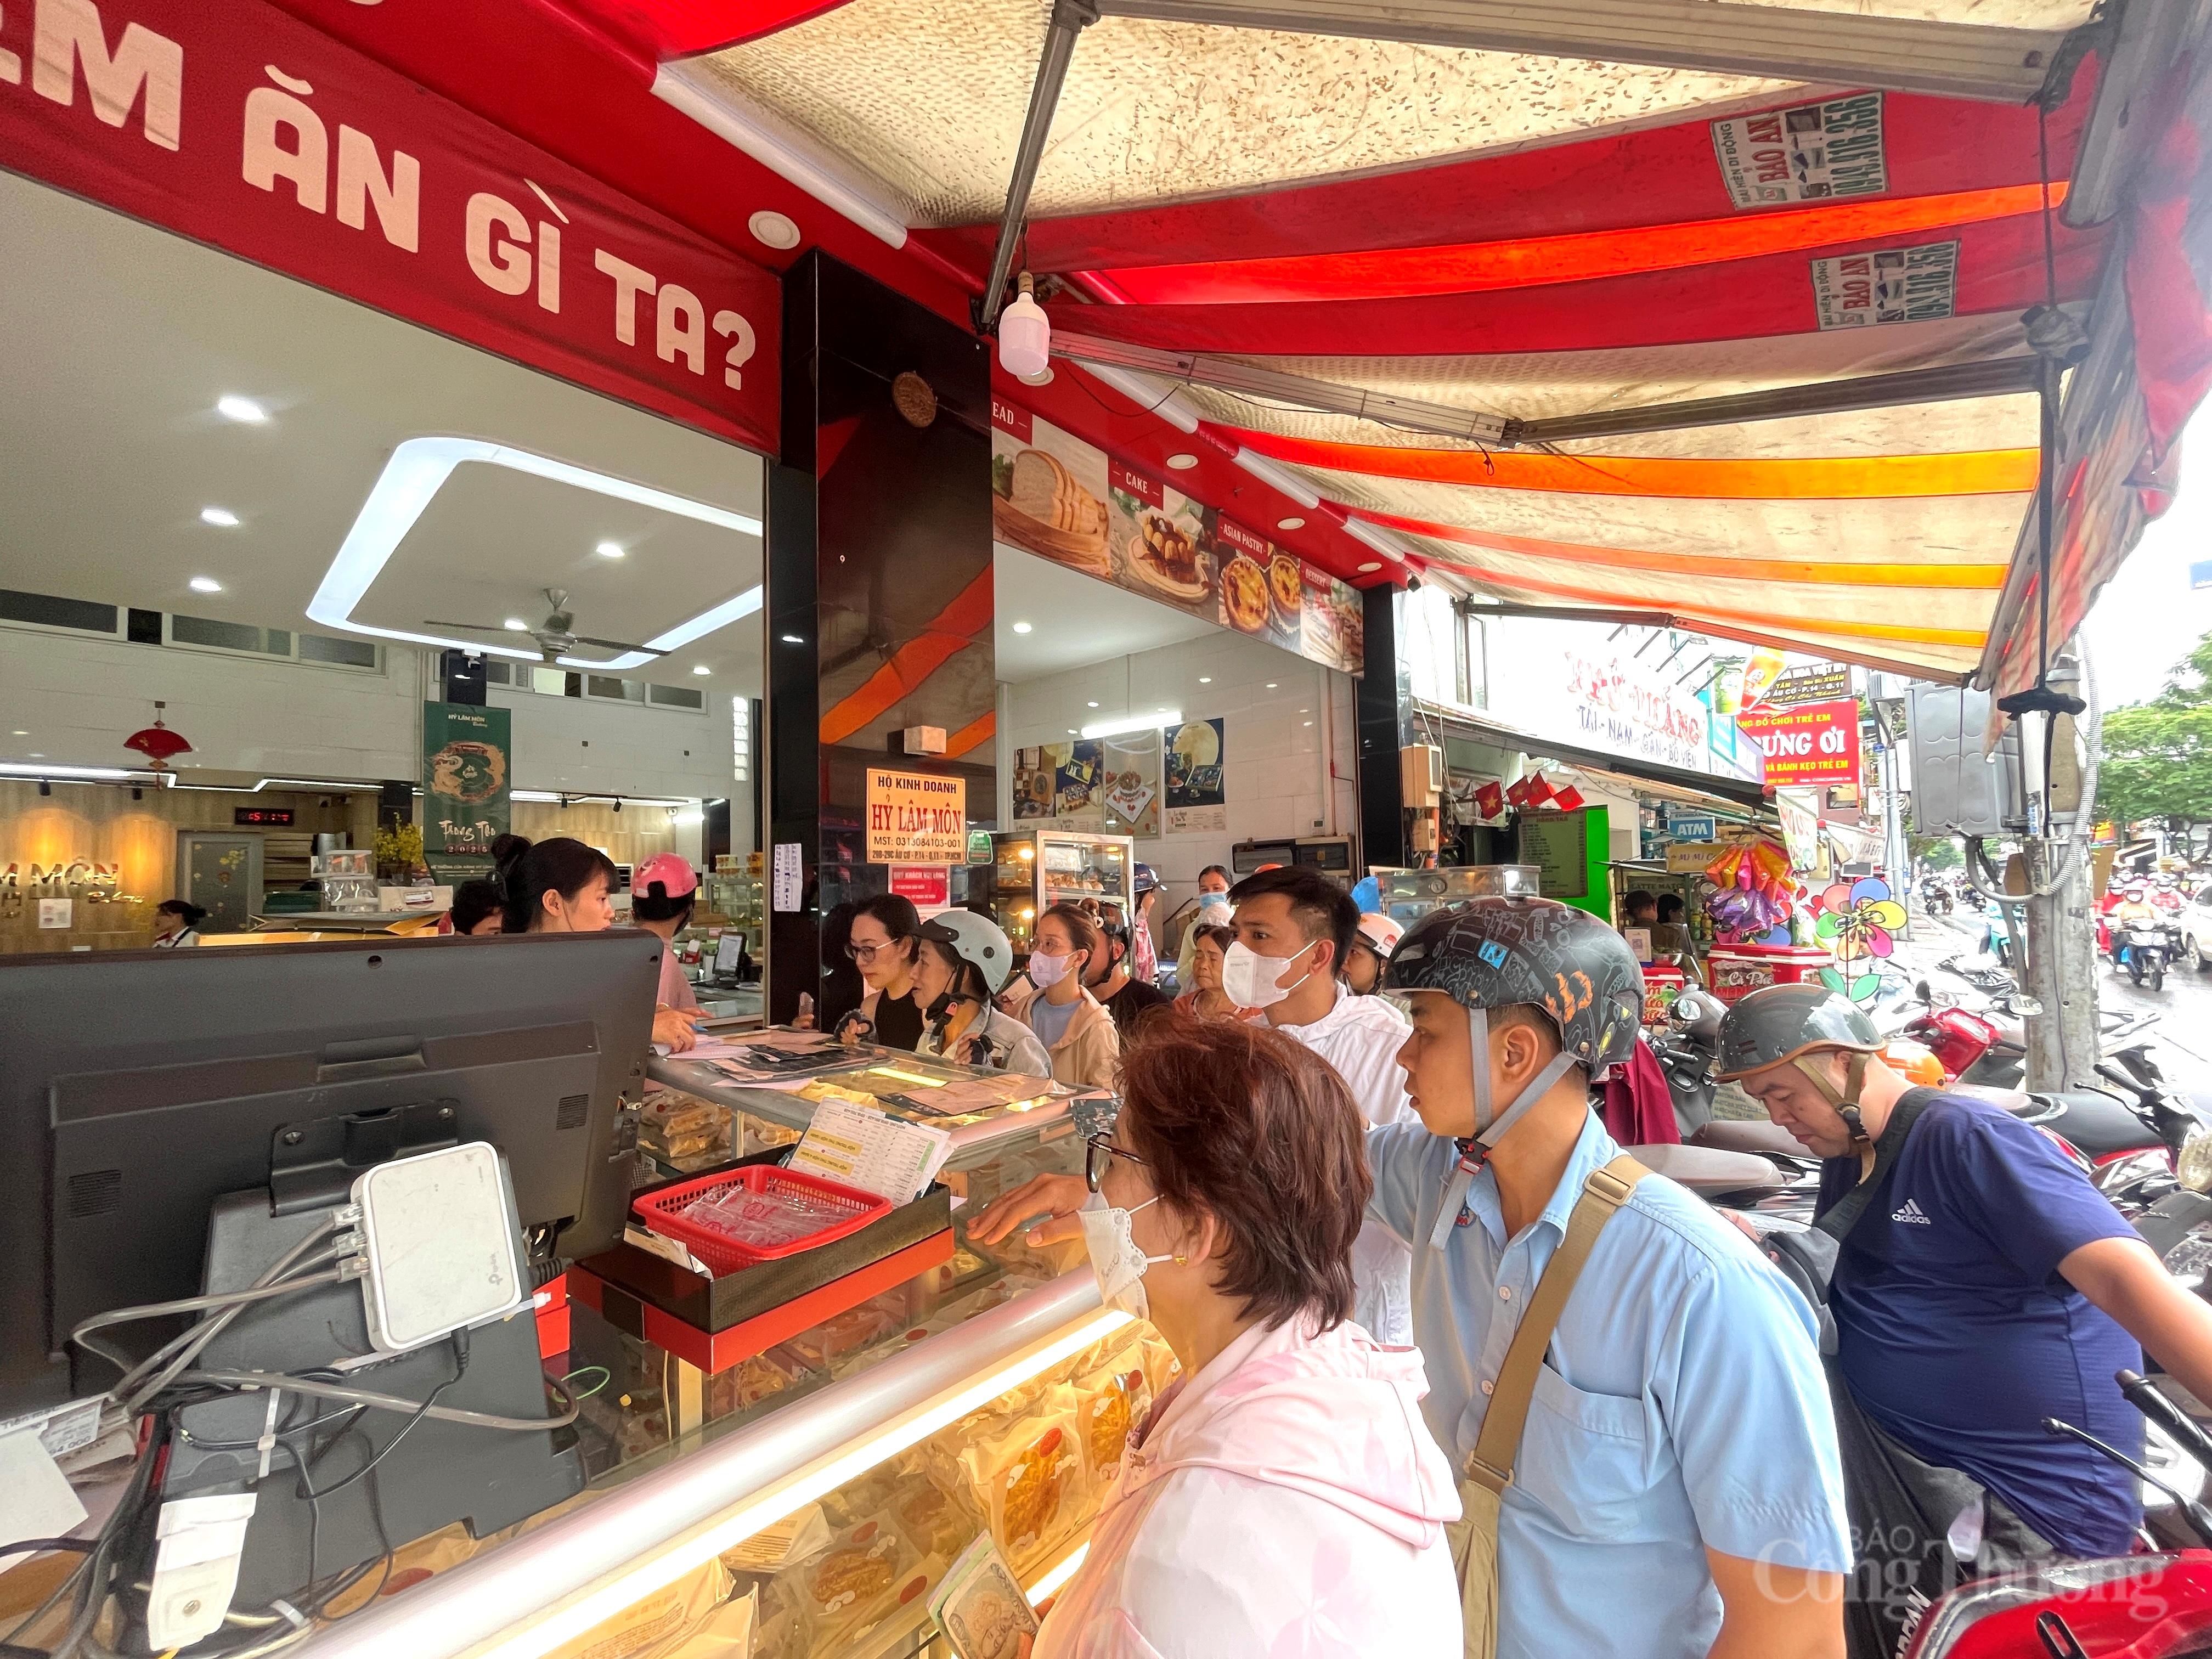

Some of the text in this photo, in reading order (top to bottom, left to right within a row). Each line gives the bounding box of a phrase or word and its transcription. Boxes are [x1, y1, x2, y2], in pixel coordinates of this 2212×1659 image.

[1721, 123, 1737, 154] ĐỘNG
[1743, 117, 1790, 183] BẢO AN
[1728, 156, 1739, 167] DI
[1732, 169, 1746, 188] HIÊN
[0, 0, 755, 391] M ĂN GÌ TA?
[1816, 261, 1828, 284] ĐỘNG
[1832, 257, 1870, 309] BẢO AN
[1126, 472, 1148, 494] CAKE
[1223, 523, 1264, 554] ASIAN PASTRY
[1306, 568, 1326, 587] DESSERT
[1771, 716, 1793, 726] CHƠI
[1797, 713, 1813, 723] TRẺ
[1816, 714, 1831, 722] EM
[1778, 761, 1798, 771] BÁNH
[1800, 761, 1816, 772] KẸO
[1818, 759, 1834, 769] TRẺ
[1836, 760, 1848, 768] EM
[878, 775, 956, 794] HỘ KINH DOANH
[872, 794, 961, 834] HỶ LÂM MÔN
[1677, 823, 1708, 836] ATM
[874, 836, 893, 845] MST:
[896, 837, 960, 848] 0313084103-001
[1892, 1213, 1931, 1224] adidas
